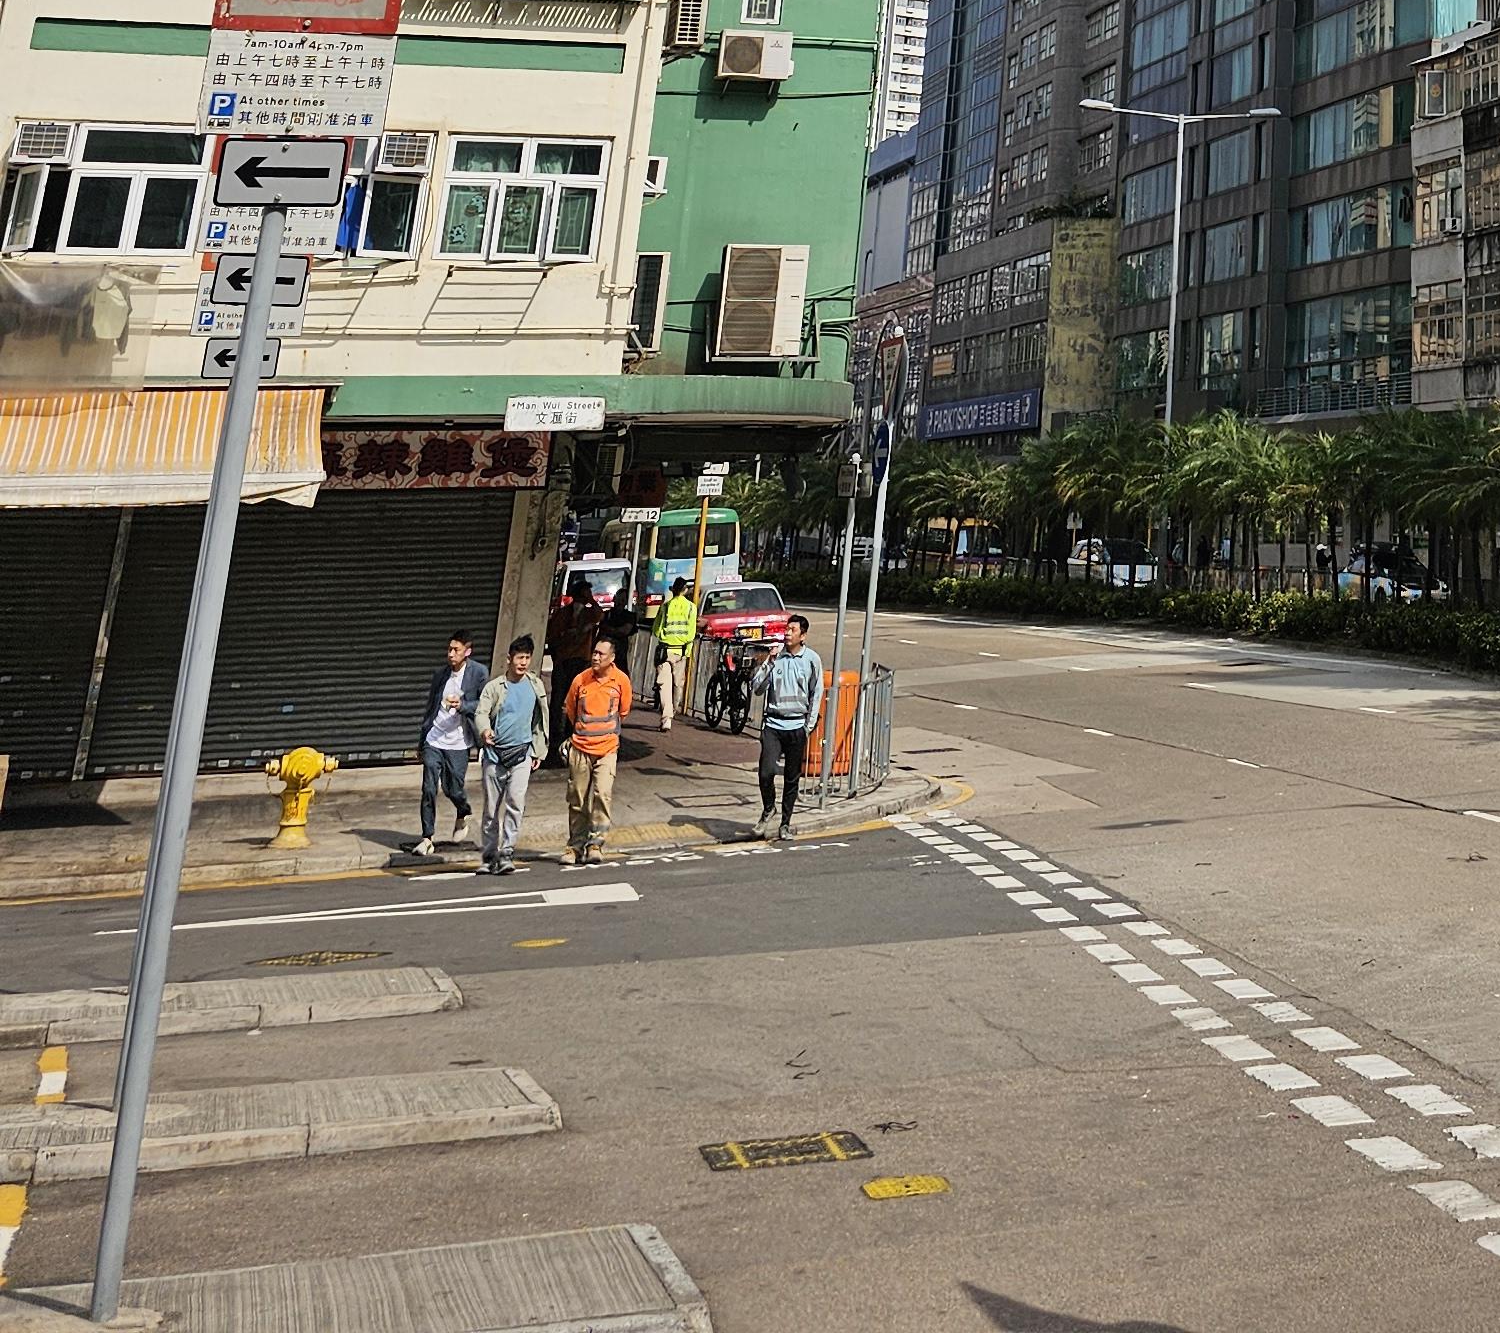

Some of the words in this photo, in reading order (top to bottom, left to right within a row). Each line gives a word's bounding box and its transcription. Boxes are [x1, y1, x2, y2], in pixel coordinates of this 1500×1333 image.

[215, 53, 386, 71] 由上午七時至上午十時
[212, 72, 383, 90] 由下午四時至下午七時
[239, 95, 253, 105] At
[257, 96, 289, 106] other
[293, 97, 325, 107] times
[237, 111, 374, 127] 其他時間則准泊車
[209, 206, 335, 220] 由下午四下午七時
[517, 401, 537, 410] Man
[542, 401, 560, 410] Wui
[566, 401, 597, 410] Street
[535, 411, 578, 425] 文匯街
[645, 510, 658, 520] 12
